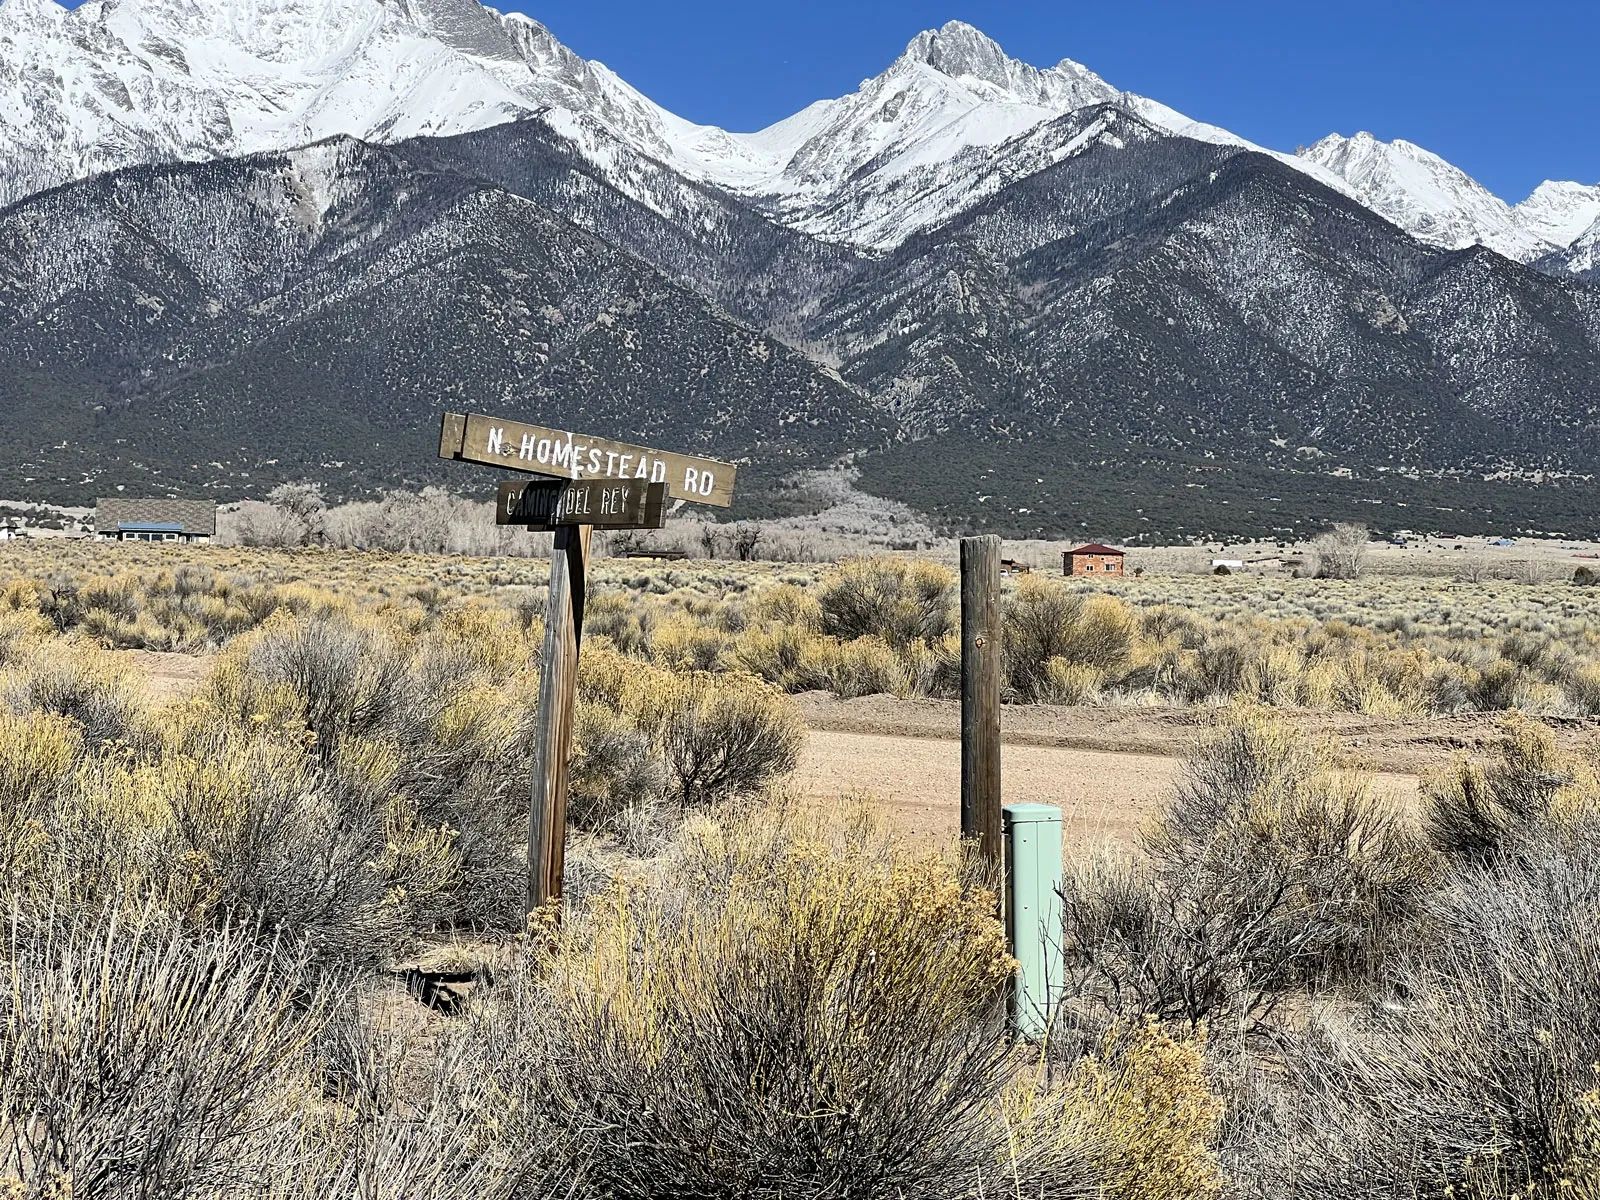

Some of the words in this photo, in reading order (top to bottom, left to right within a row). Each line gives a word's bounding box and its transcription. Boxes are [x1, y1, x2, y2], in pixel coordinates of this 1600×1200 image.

[519, 432, 666, 483] HOMESTEAD
[684, 467, 714, 496] RD
[565, 486, 592, 515] DEL
[600, 485, 631, 515] REY
